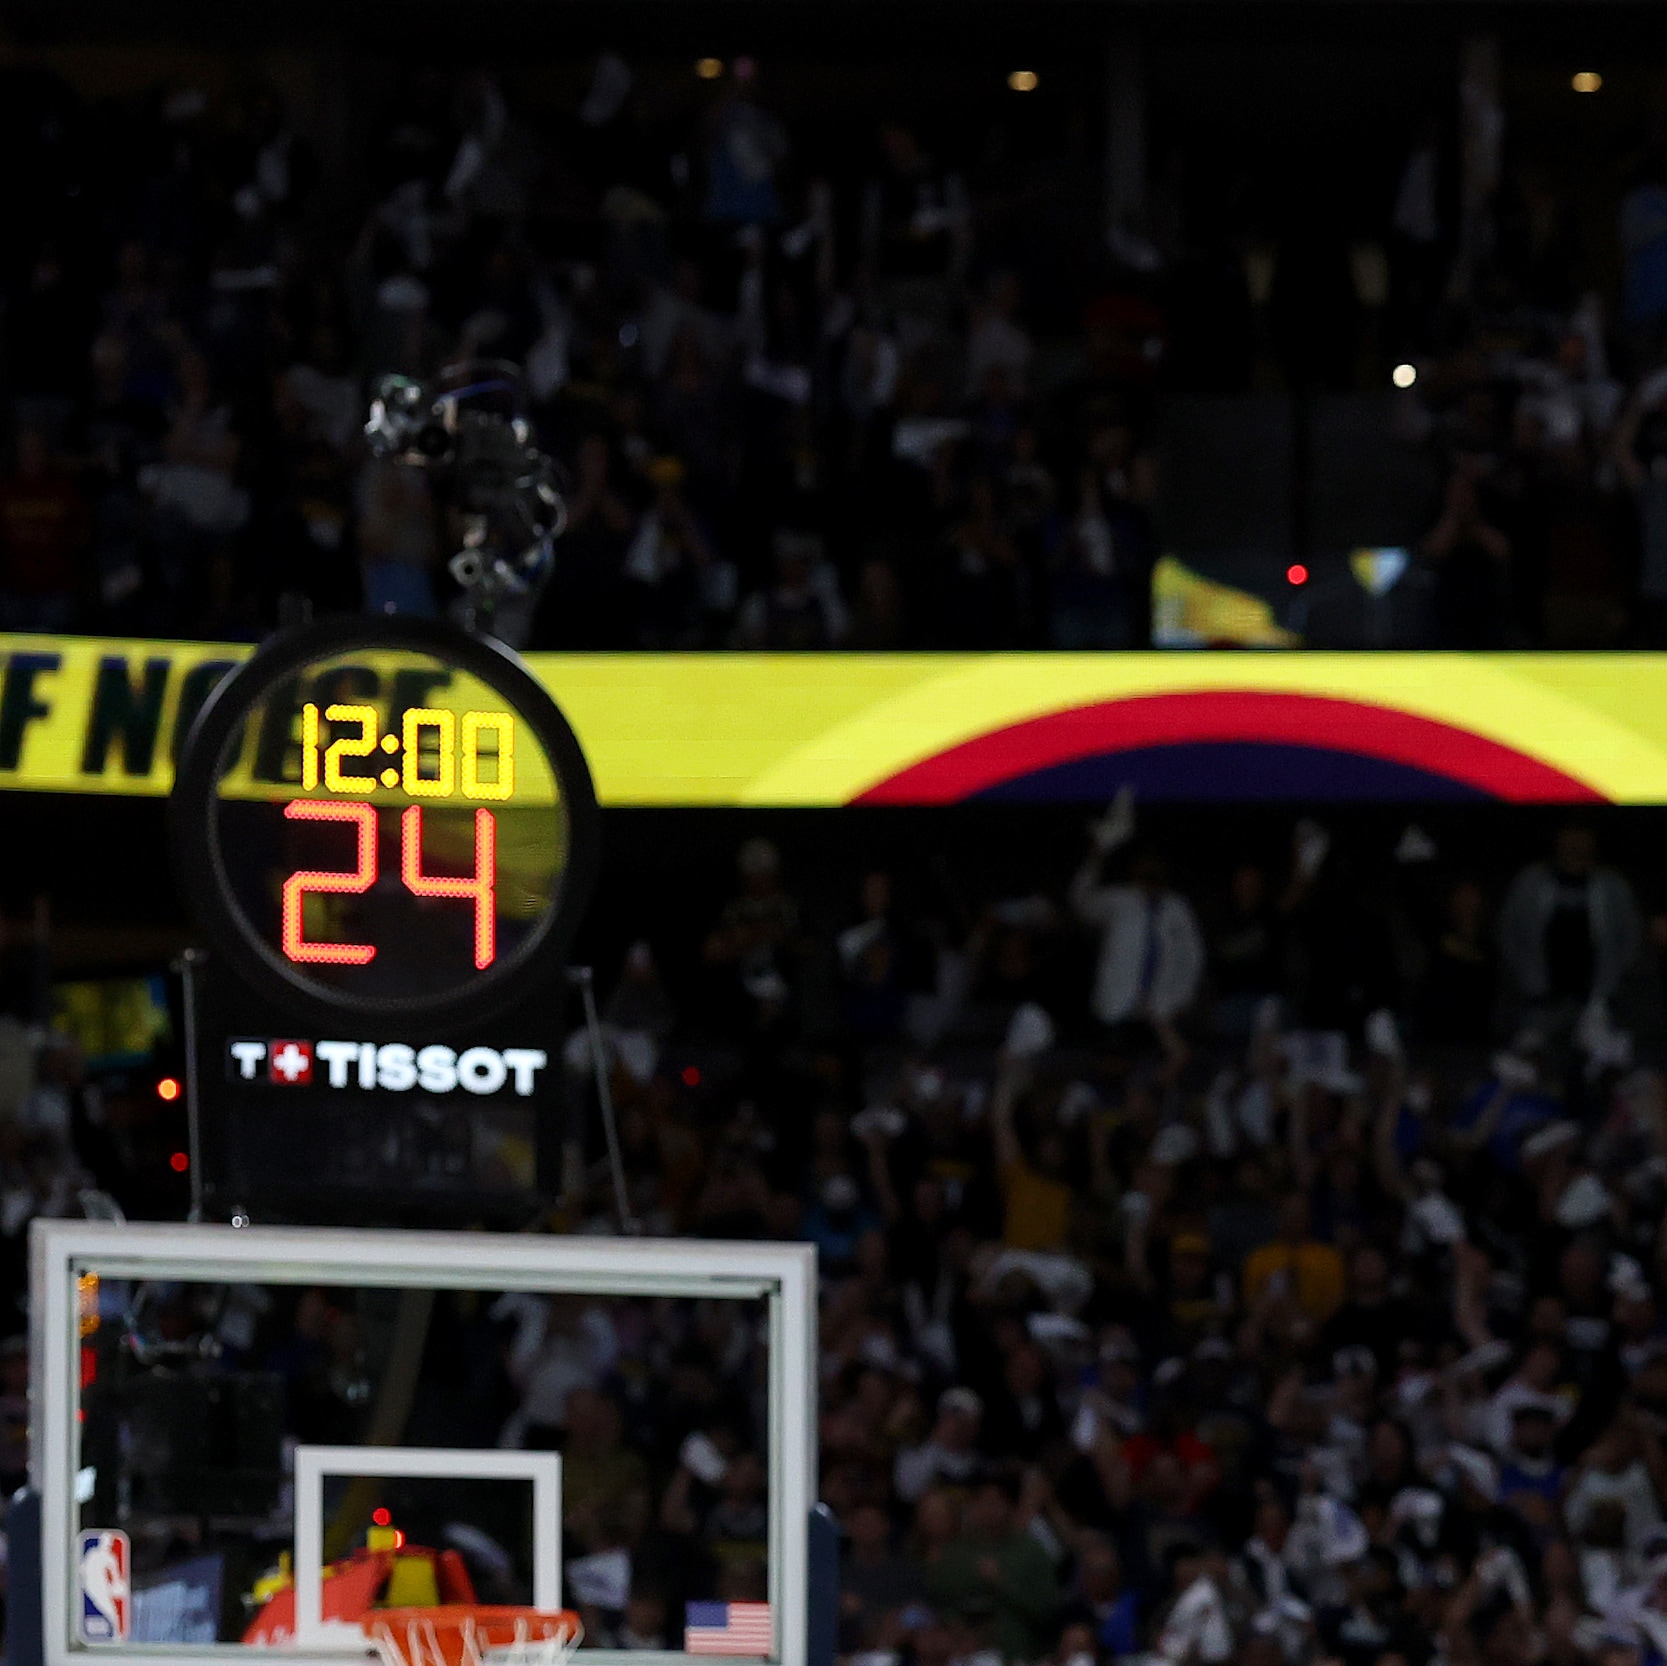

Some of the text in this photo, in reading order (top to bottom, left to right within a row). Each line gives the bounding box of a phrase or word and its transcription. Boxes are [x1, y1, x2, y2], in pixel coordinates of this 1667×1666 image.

[302, 702, 515, 801] 12:00
[282, 801, 496, 970] 24
[315, 1042, 548, 1097] TISSOT
